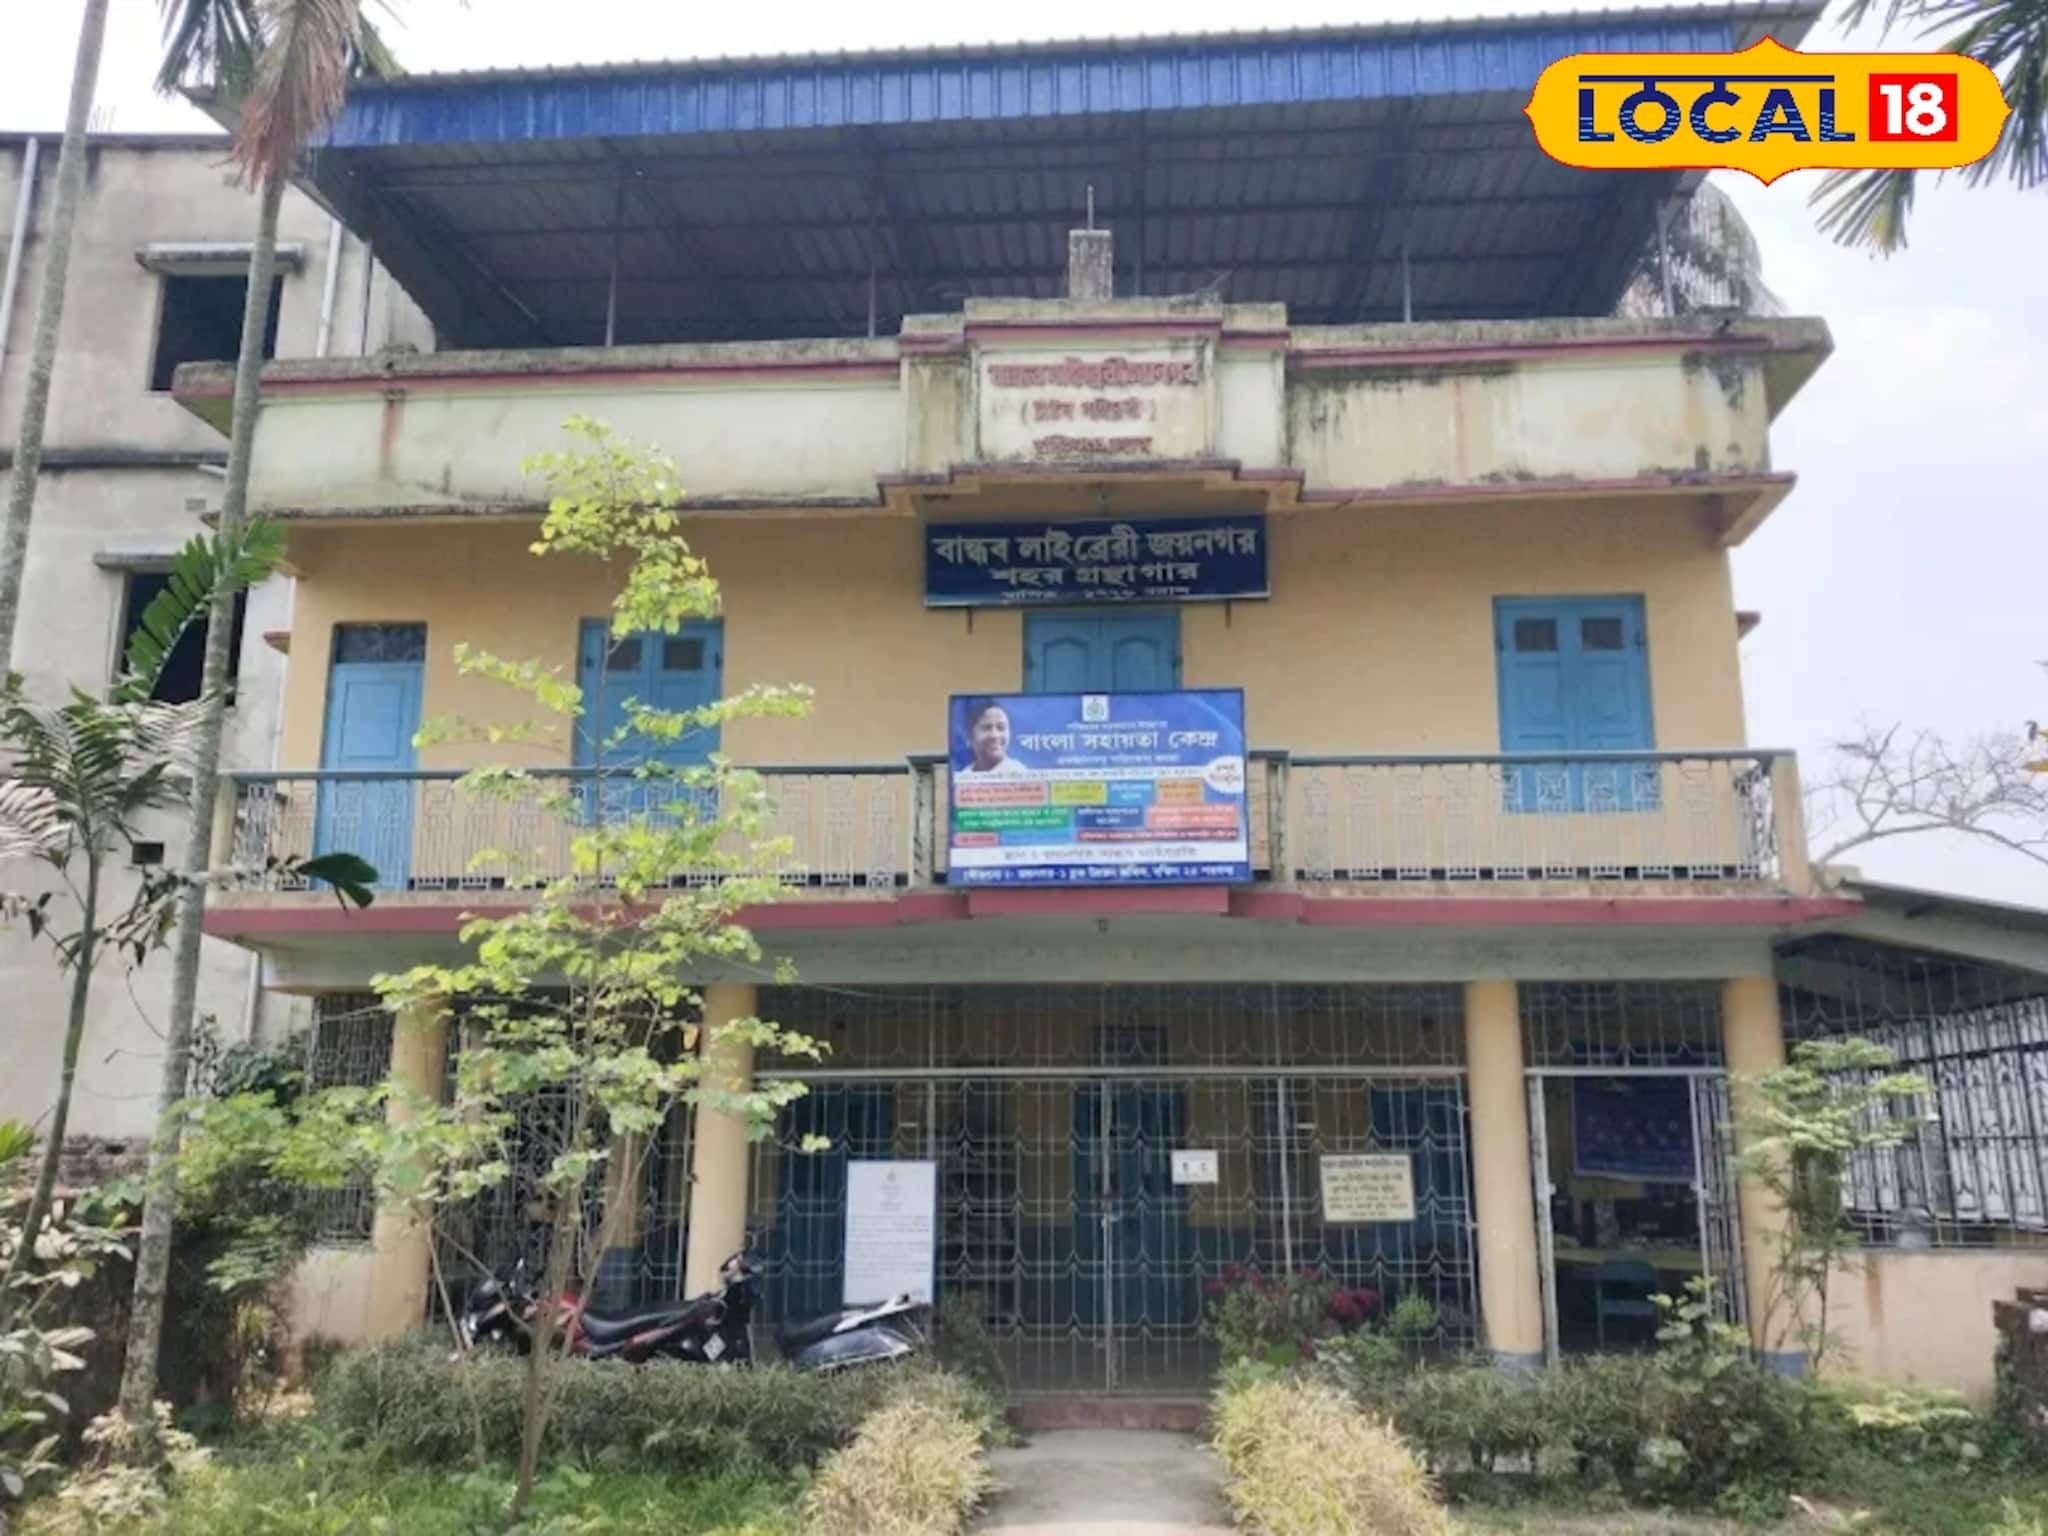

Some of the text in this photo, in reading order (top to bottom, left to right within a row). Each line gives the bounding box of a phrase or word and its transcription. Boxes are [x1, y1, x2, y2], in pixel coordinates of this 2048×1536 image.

[1146, 526, 1257, 558] জয়নগর
[988, 565, 1064, 587] শহর
[1018, 729, 1219, 752] বাংলা সহায়তা কেন্দ্র
